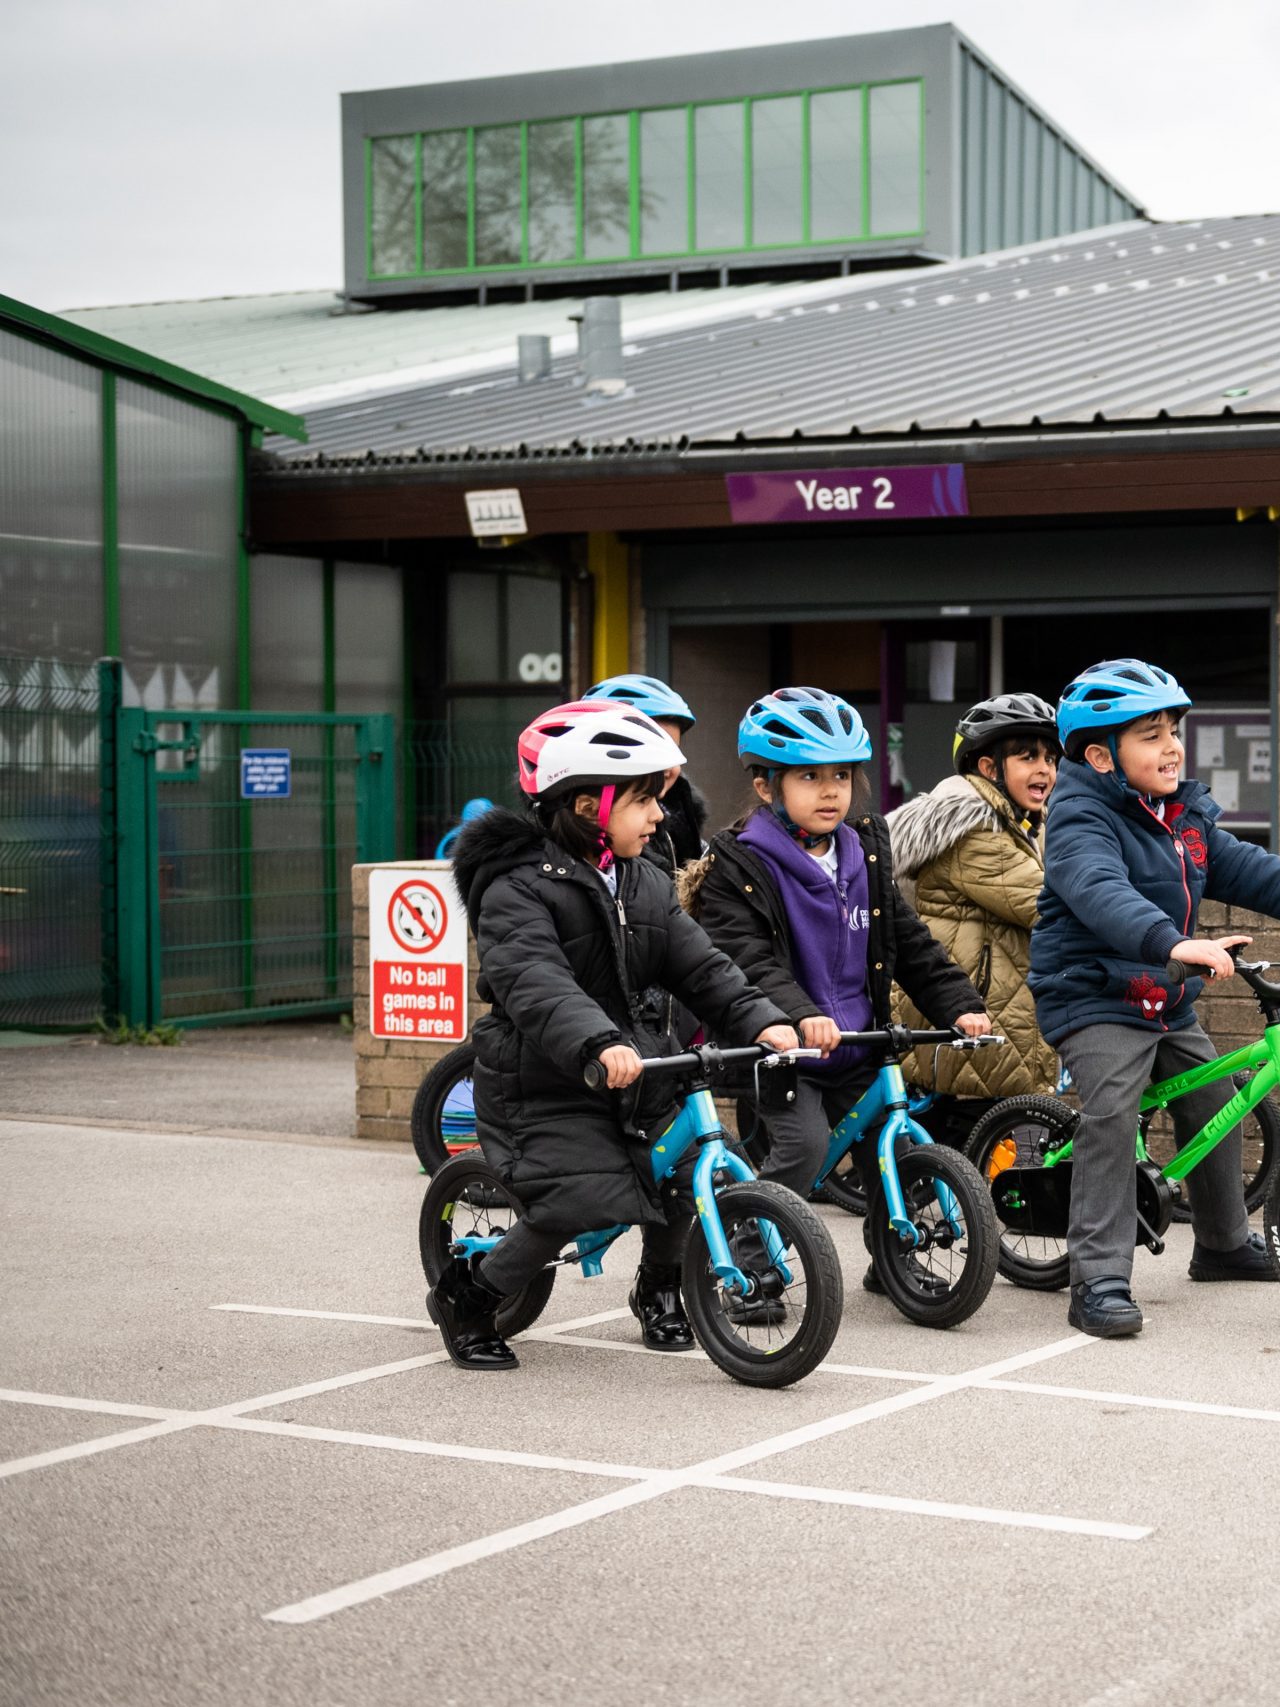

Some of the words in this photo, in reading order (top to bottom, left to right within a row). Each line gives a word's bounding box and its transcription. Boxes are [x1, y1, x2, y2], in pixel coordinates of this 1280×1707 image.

[795, 479, 862, 511] Year
[873, 477, 895, 509] 2
[390, 966, 413, 985] No
[417, 966, 446, 986] ball
[383, 993, 436, 1012] games
[440, 992, 455, 1011] in
[384, 1013, 414, 1032] this
[418, 1018, 454, 1034] area
[1156, 1077, 1189, 1098] CP14
